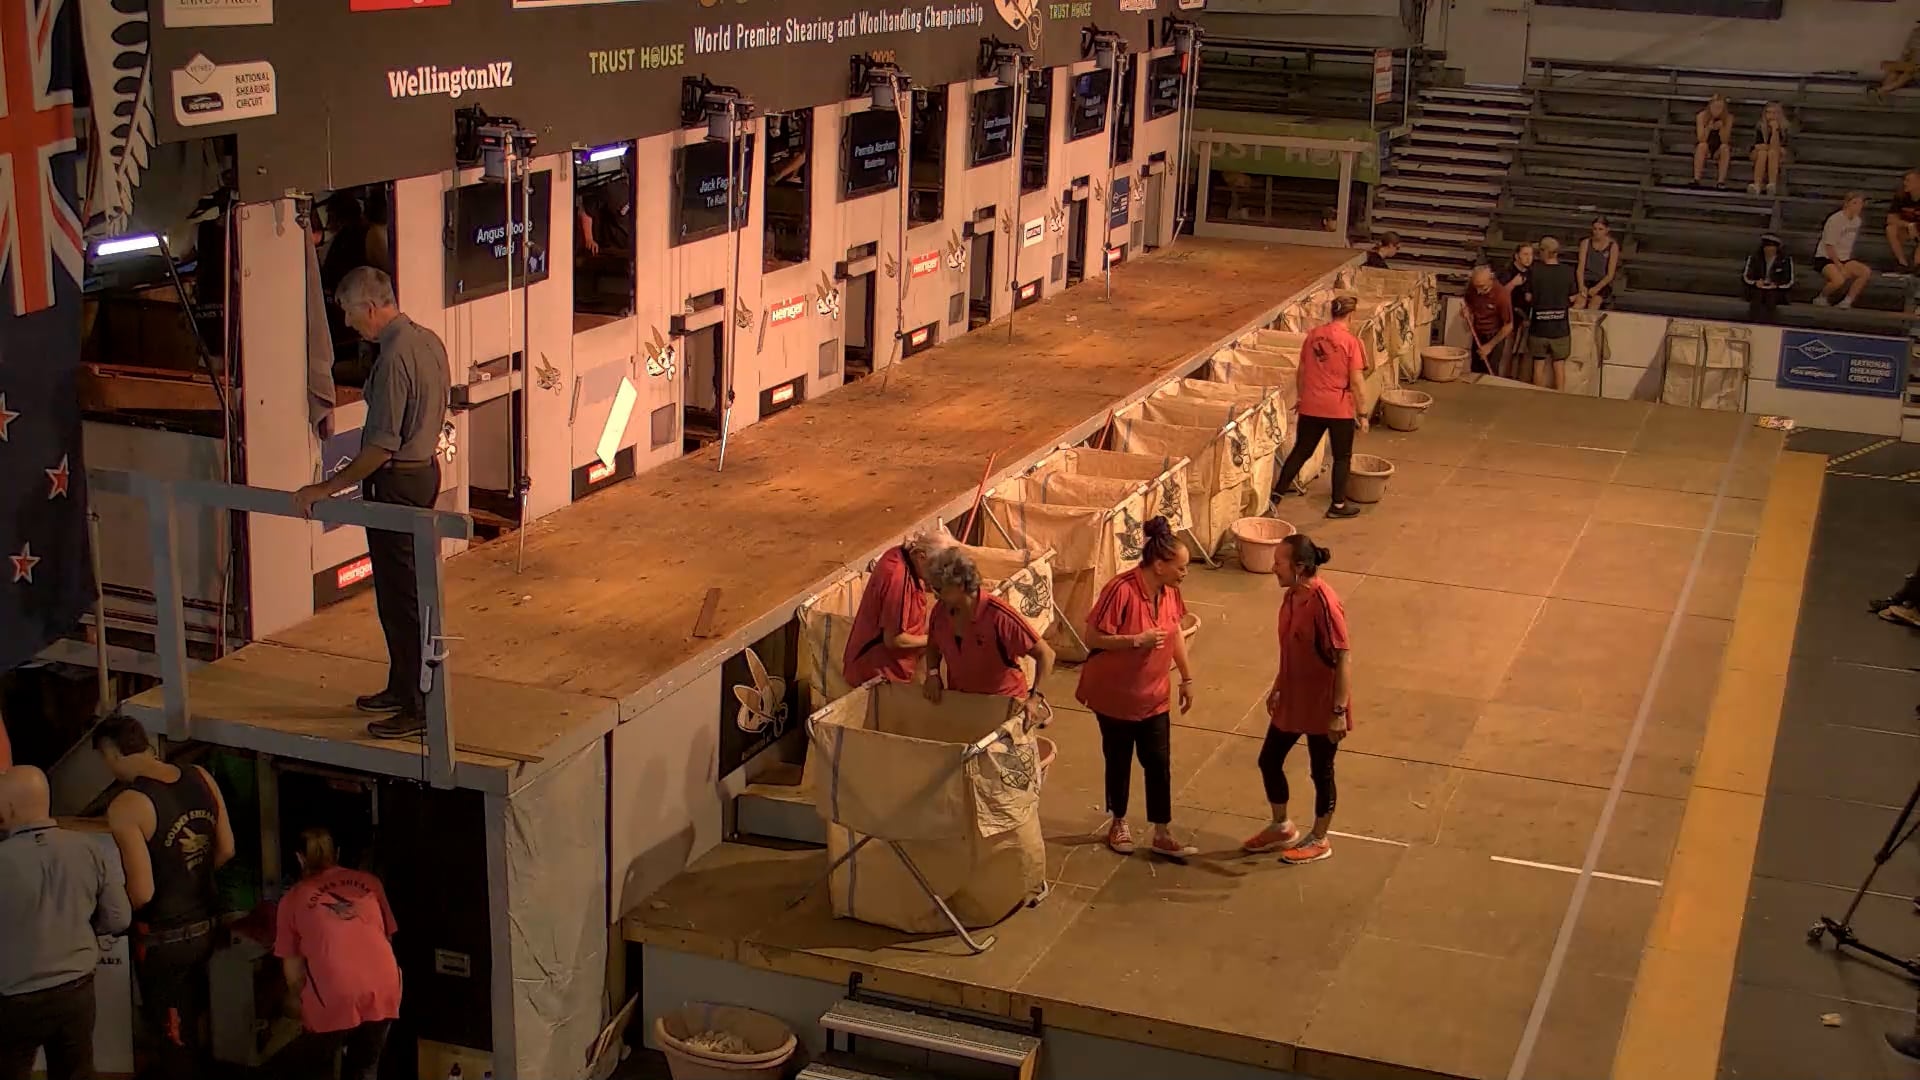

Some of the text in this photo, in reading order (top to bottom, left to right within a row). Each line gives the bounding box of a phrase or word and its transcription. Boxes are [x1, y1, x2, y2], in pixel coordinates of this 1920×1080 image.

[1049, 4, 1070, 20] TRUST
[694, 2, 983, 54] World Premier Shearing and Woolhandling Championship
[589, 43, 685, 74] TRUST HOUSE
[235, 71, 271, 85] NATIONAL
[388, 61, 513, 98] WellingtonNZ
[476, 226, 505, 244] Angus
[494, 241, 515, 258] Wad
